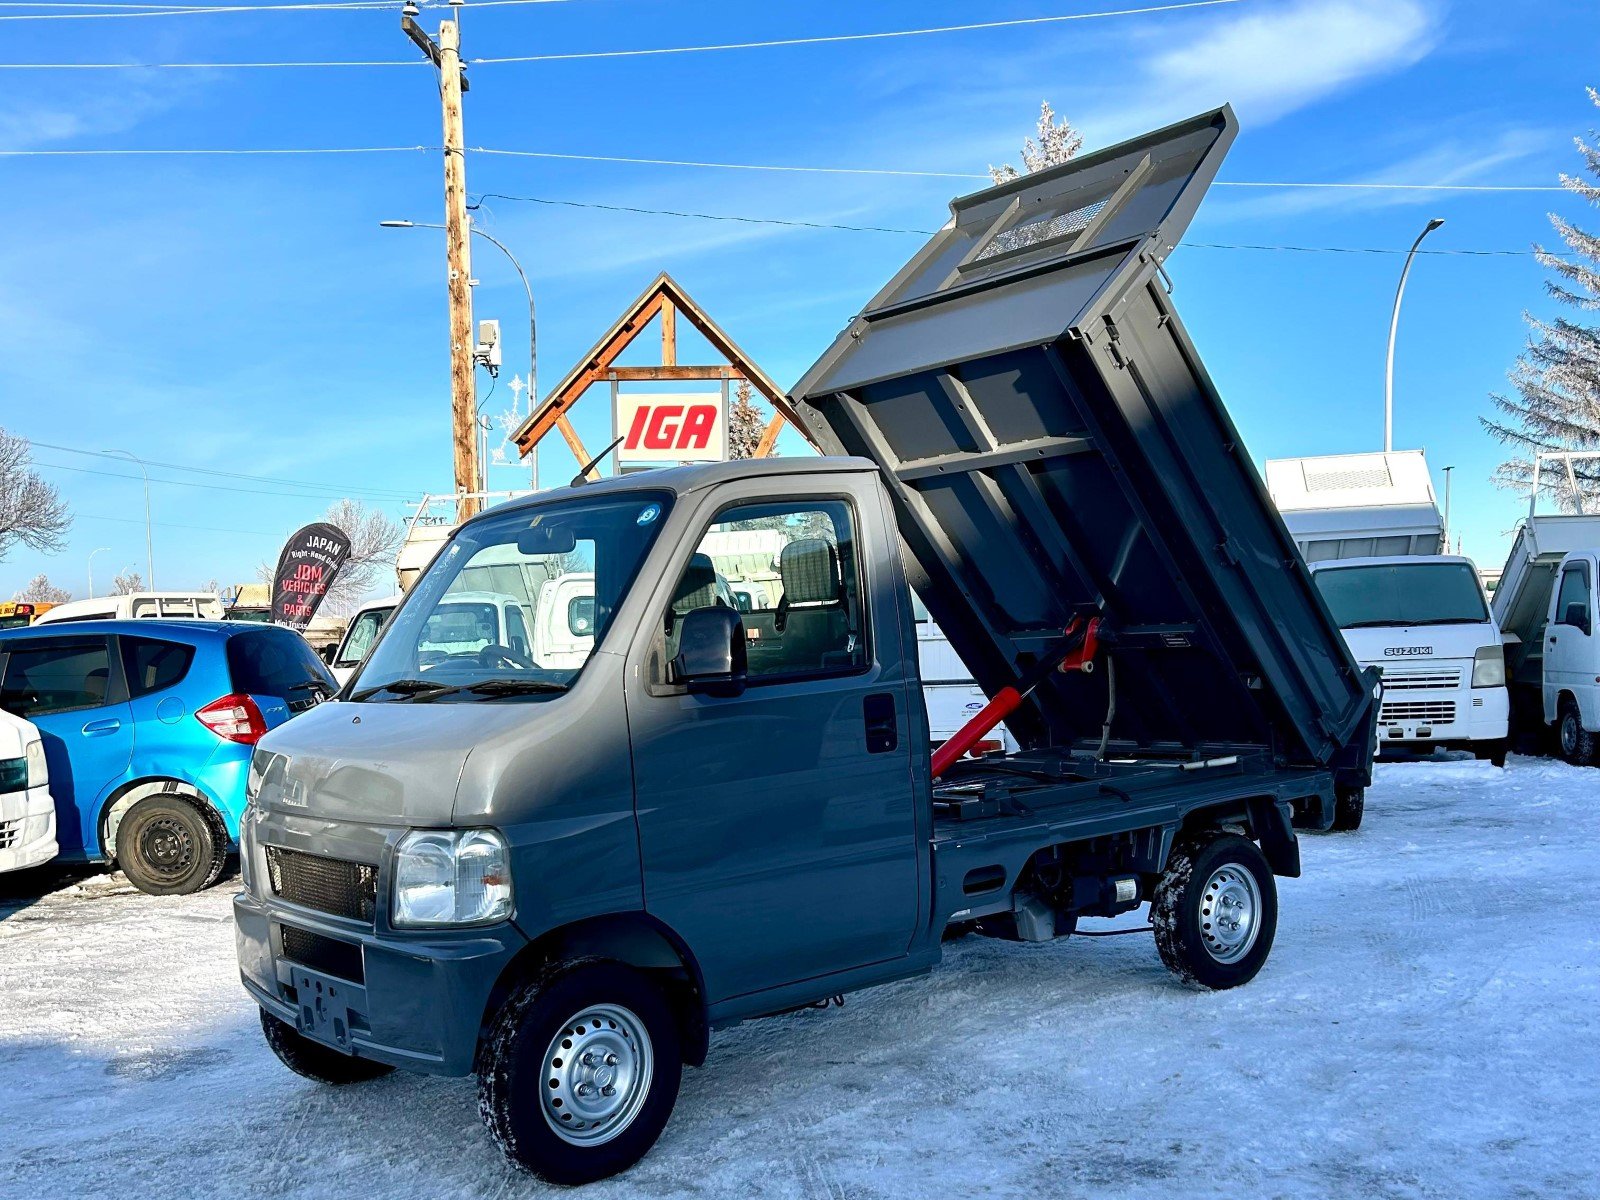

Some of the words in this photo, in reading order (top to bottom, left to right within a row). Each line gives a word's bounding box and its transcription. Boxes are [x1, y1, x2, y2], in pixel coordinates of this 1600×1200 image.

[623, 405, 717, 449] IGA
[306, 536, 341, 555] JAPAN
[293, 565, 323, 580] JDM
[282, 580, 326, 594] VEHICLES
[297, 594, 304, 603] &
[283, 603, 312, 616] PARTS
[1384, 646, 1433, 656] SUZUKI
